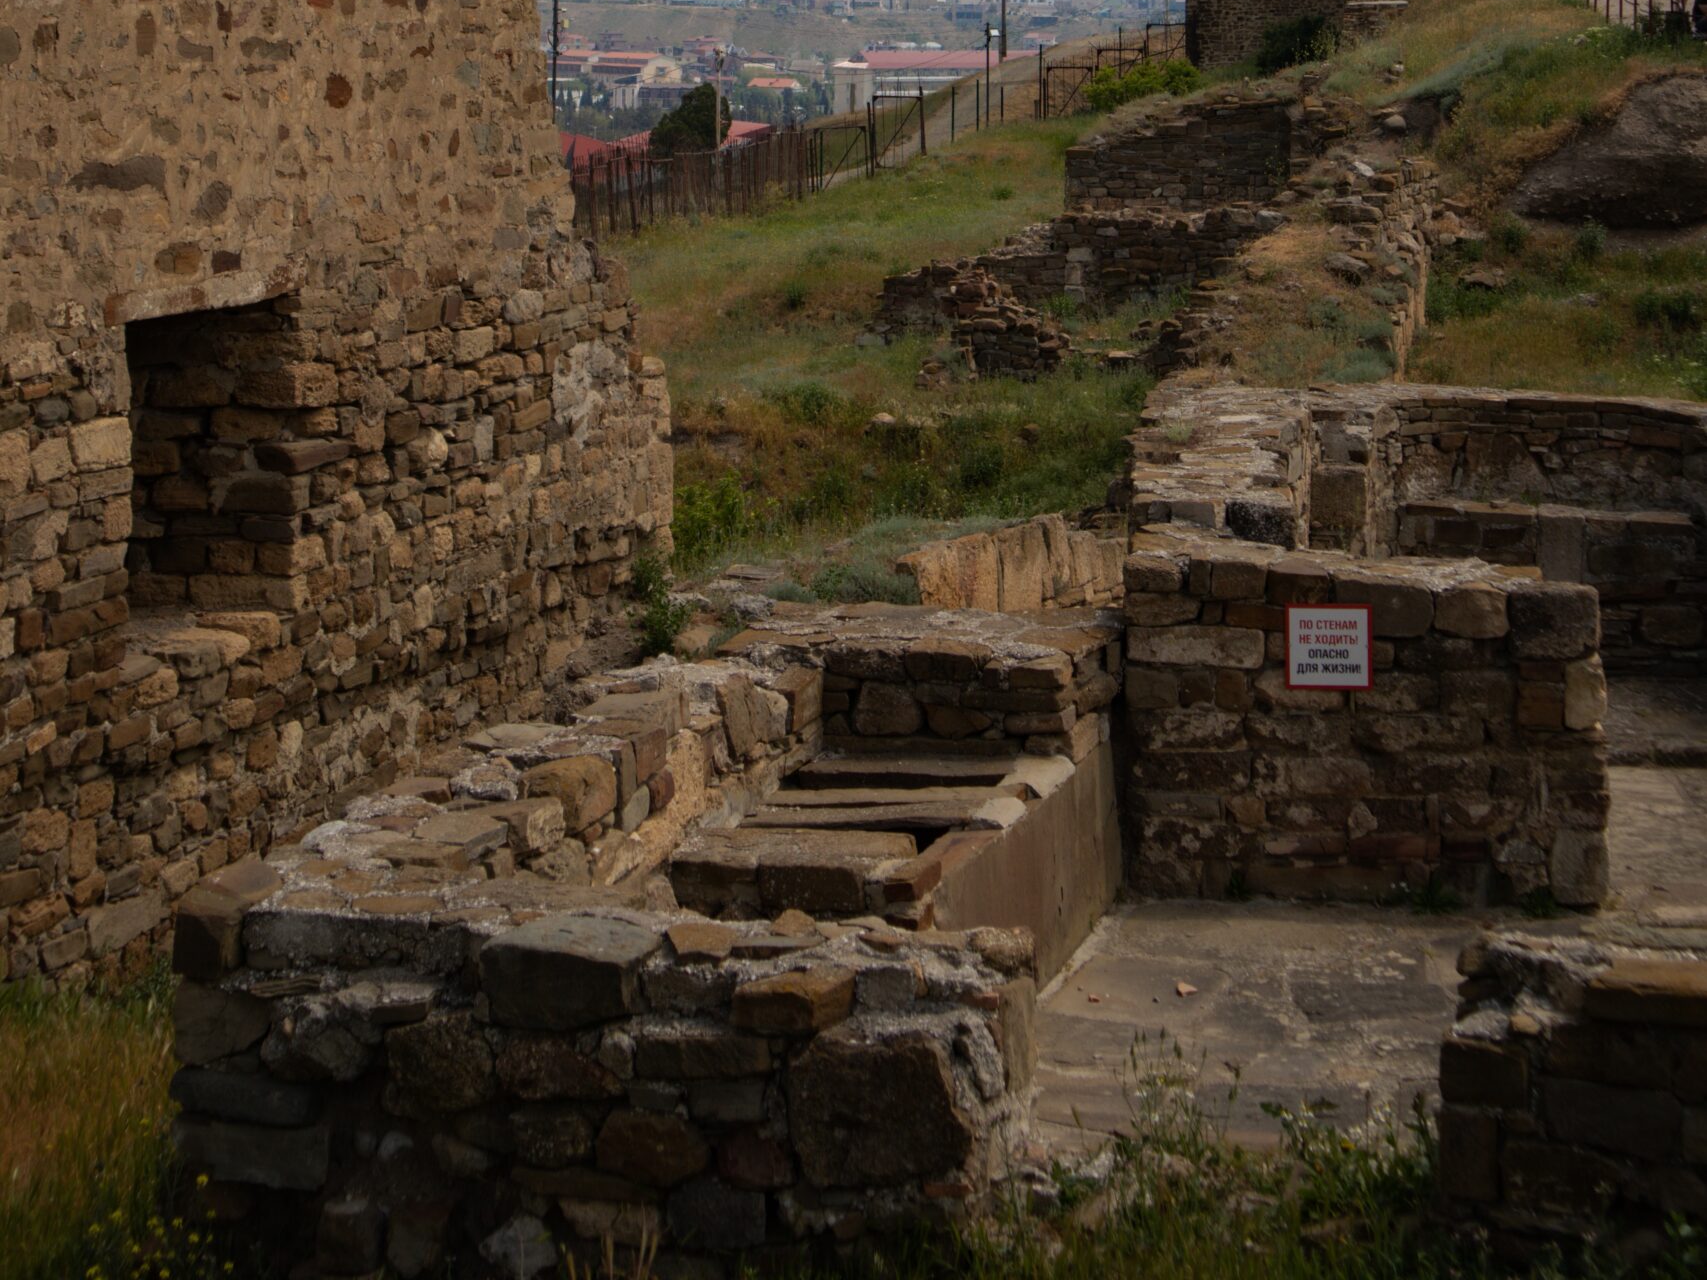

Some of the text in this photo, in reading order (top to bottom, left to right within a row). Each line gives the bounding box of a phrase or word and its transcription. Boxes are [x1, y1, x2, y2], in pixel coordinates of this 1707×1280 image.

[1299, 619, 1358, 630] ПО СТЕНАМ
[1299, 634, 1359, 646] НЕ ХОДИТЬ!
[1308, 649, 1349, 659] ОПАСНО
[1297, 663, 1361, 674] ДЛЯ ЖИЗНИ!
